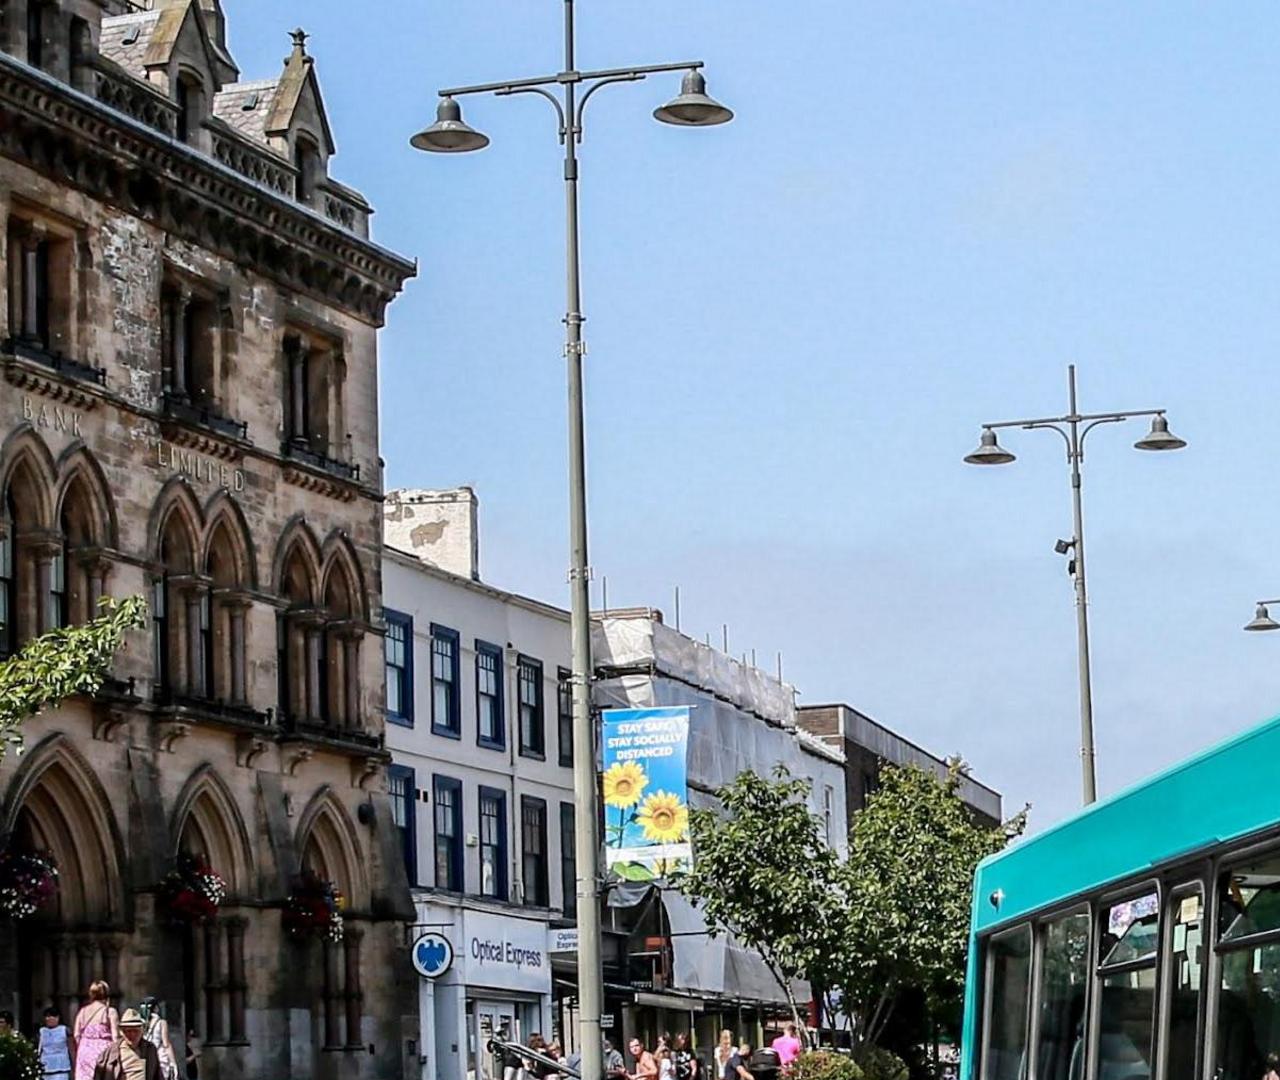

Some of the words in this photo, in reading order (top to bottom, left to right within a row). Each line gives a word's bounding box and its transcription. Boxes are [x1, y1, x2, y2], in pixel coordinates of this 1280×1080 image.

[23, 395, 84, 437] BANK
[157, 442, 245, 492] LIMITED
[617, 722, 642, 735] STAY
[608, 737, 632, 749] STAY
[633, 733, 683, 747] SOCIALLY
[616, 746, 674, 760] DISTANCED
[557, 932, 578, 941] Optica
[556, 941, 578, 949] Expre
[471, 936, 504, 966] Optical
[505, 942, 542, 970] Express
